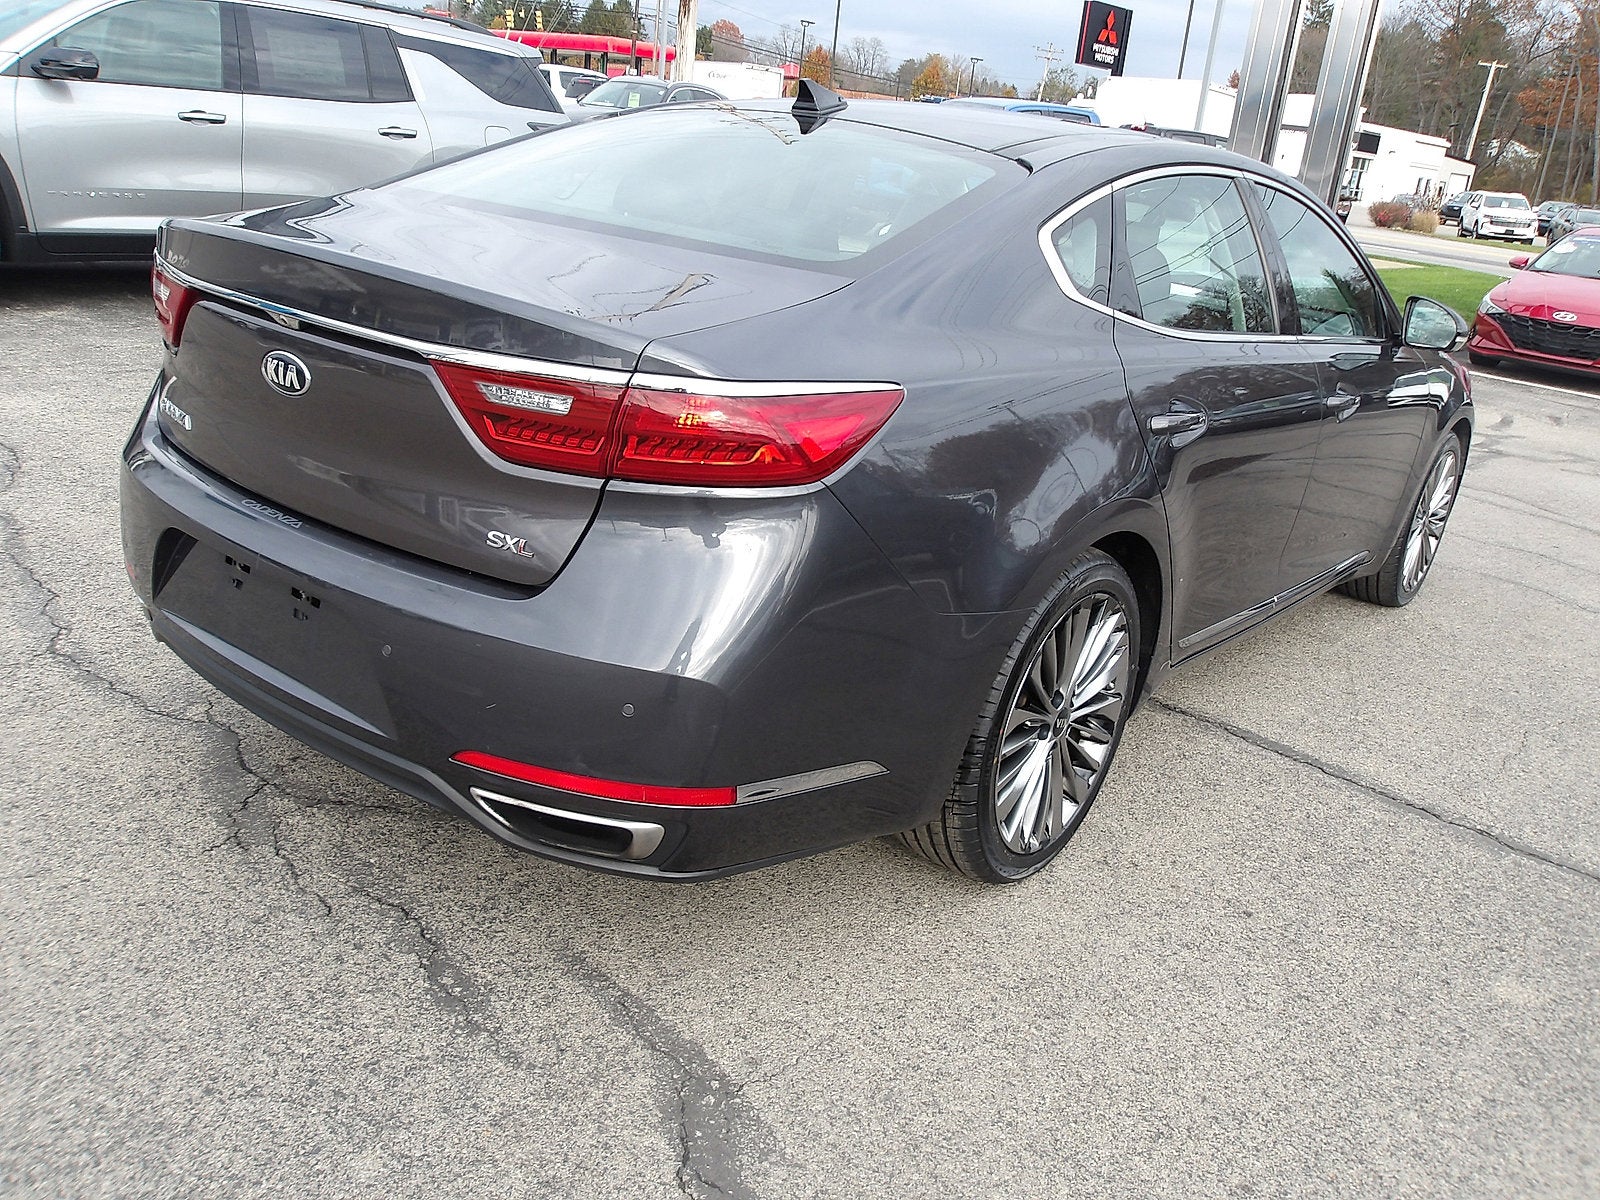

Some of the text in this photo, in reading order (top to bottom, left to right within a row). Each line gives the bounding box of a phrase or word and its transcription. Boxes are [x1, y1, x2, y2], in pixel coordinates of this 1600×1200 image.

[1094, 52, 1115, 64] MOTORS
[266, 357, 300, 390] KIA
[241, 499, 303, 529] CADENZA
[486, 530, 534, 558] SXL
